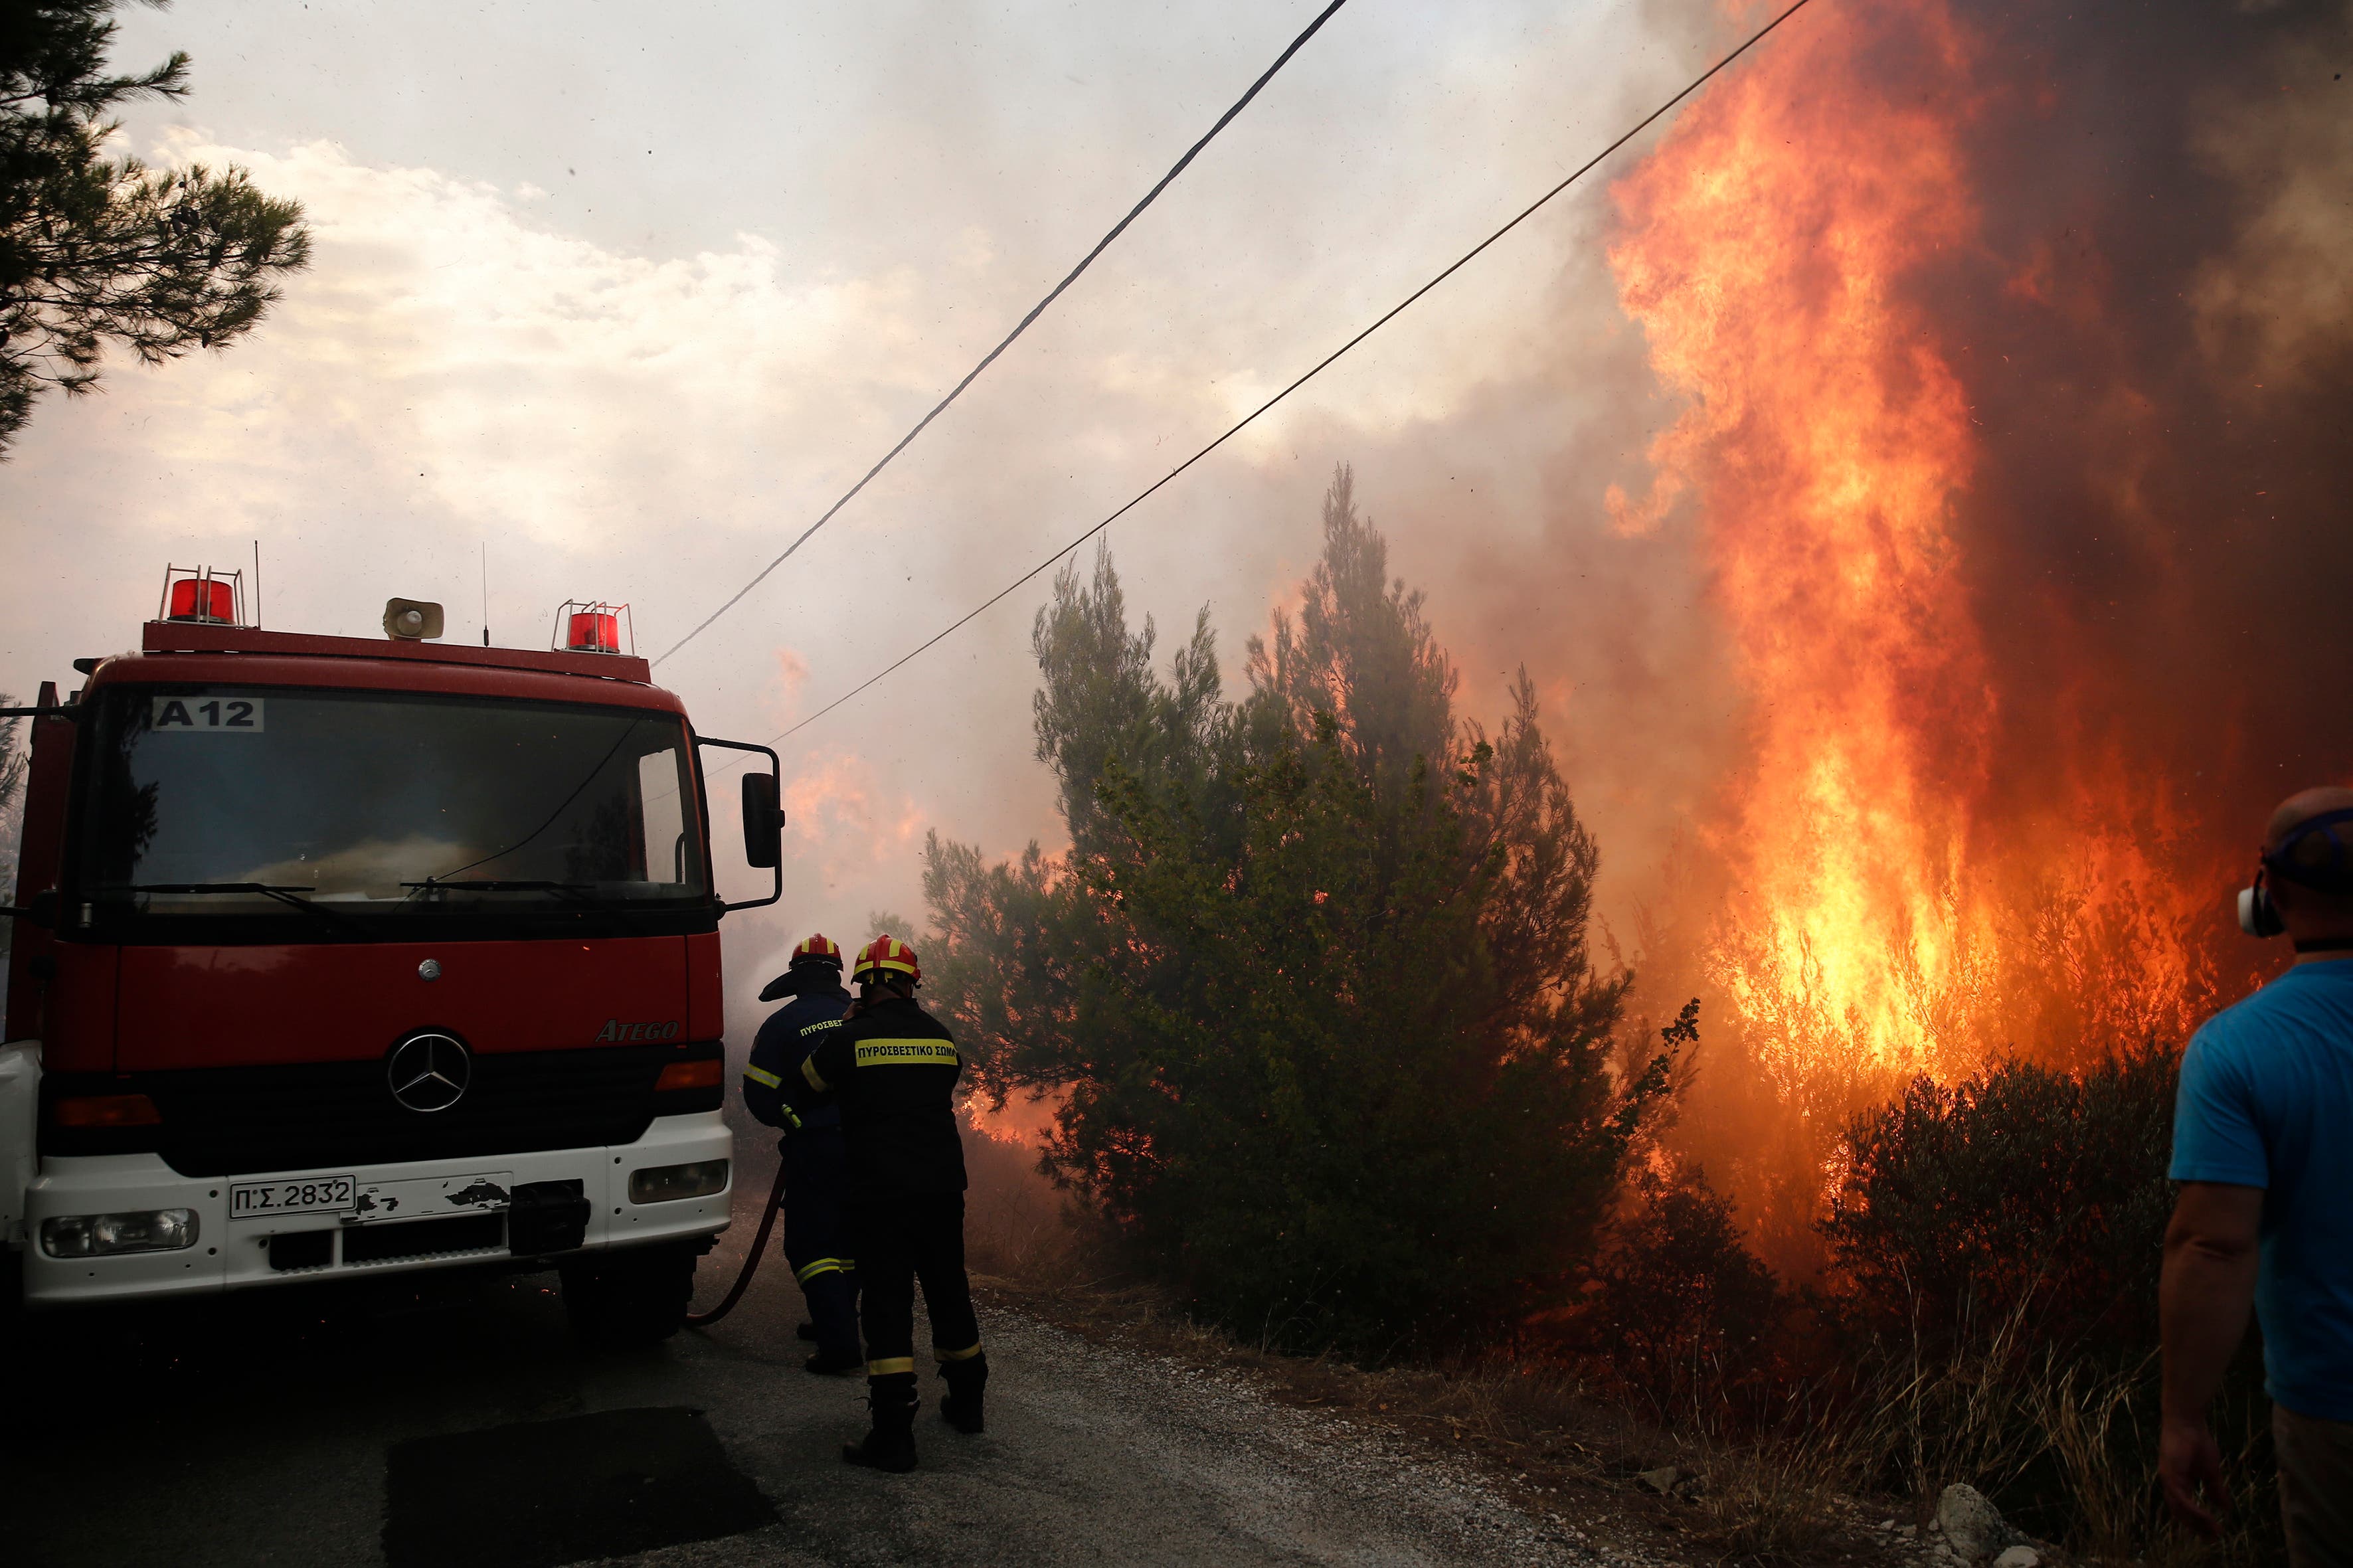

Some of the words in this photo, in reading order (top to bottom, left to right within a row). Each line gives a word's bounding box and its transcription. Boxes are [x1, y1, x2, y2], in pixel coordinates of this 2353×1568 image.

[157, 701, 254, 727] A12
[595, 1019, 679, 1042] ATEGO
[858, 1045, 933, 1058] ΠΥΡΟΣΒΕΣΤΙΚΟ
